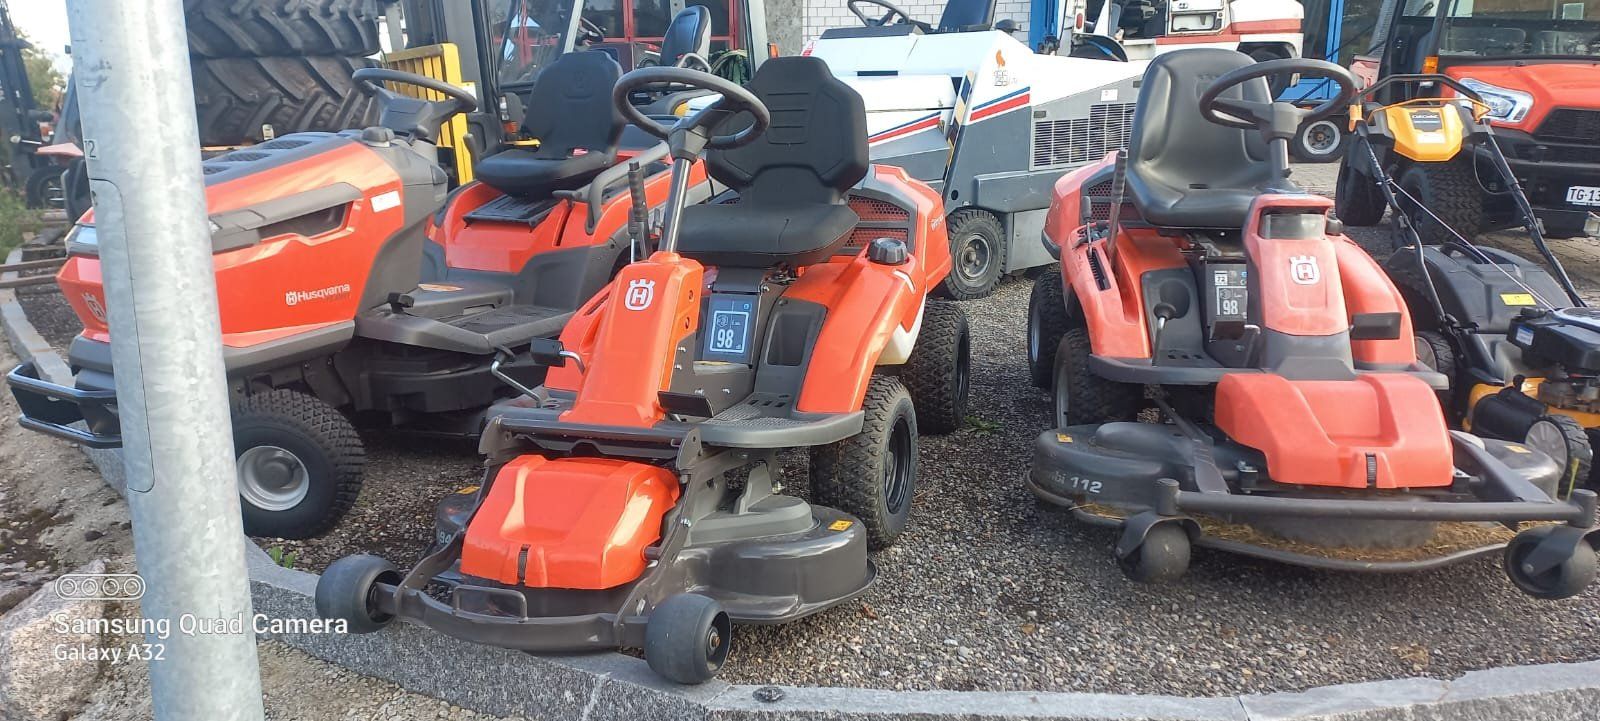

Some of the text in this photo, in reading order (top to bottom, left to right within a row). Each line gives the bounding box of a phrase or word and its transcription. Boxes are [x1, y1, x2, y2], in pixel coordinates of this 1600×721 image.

[297, 284, 351, 302] Husqvarna
[1223, 300, 1238, 315] 98
[716, 329, 734, 349] 98
[1070, 476, 1102, 494] 112
